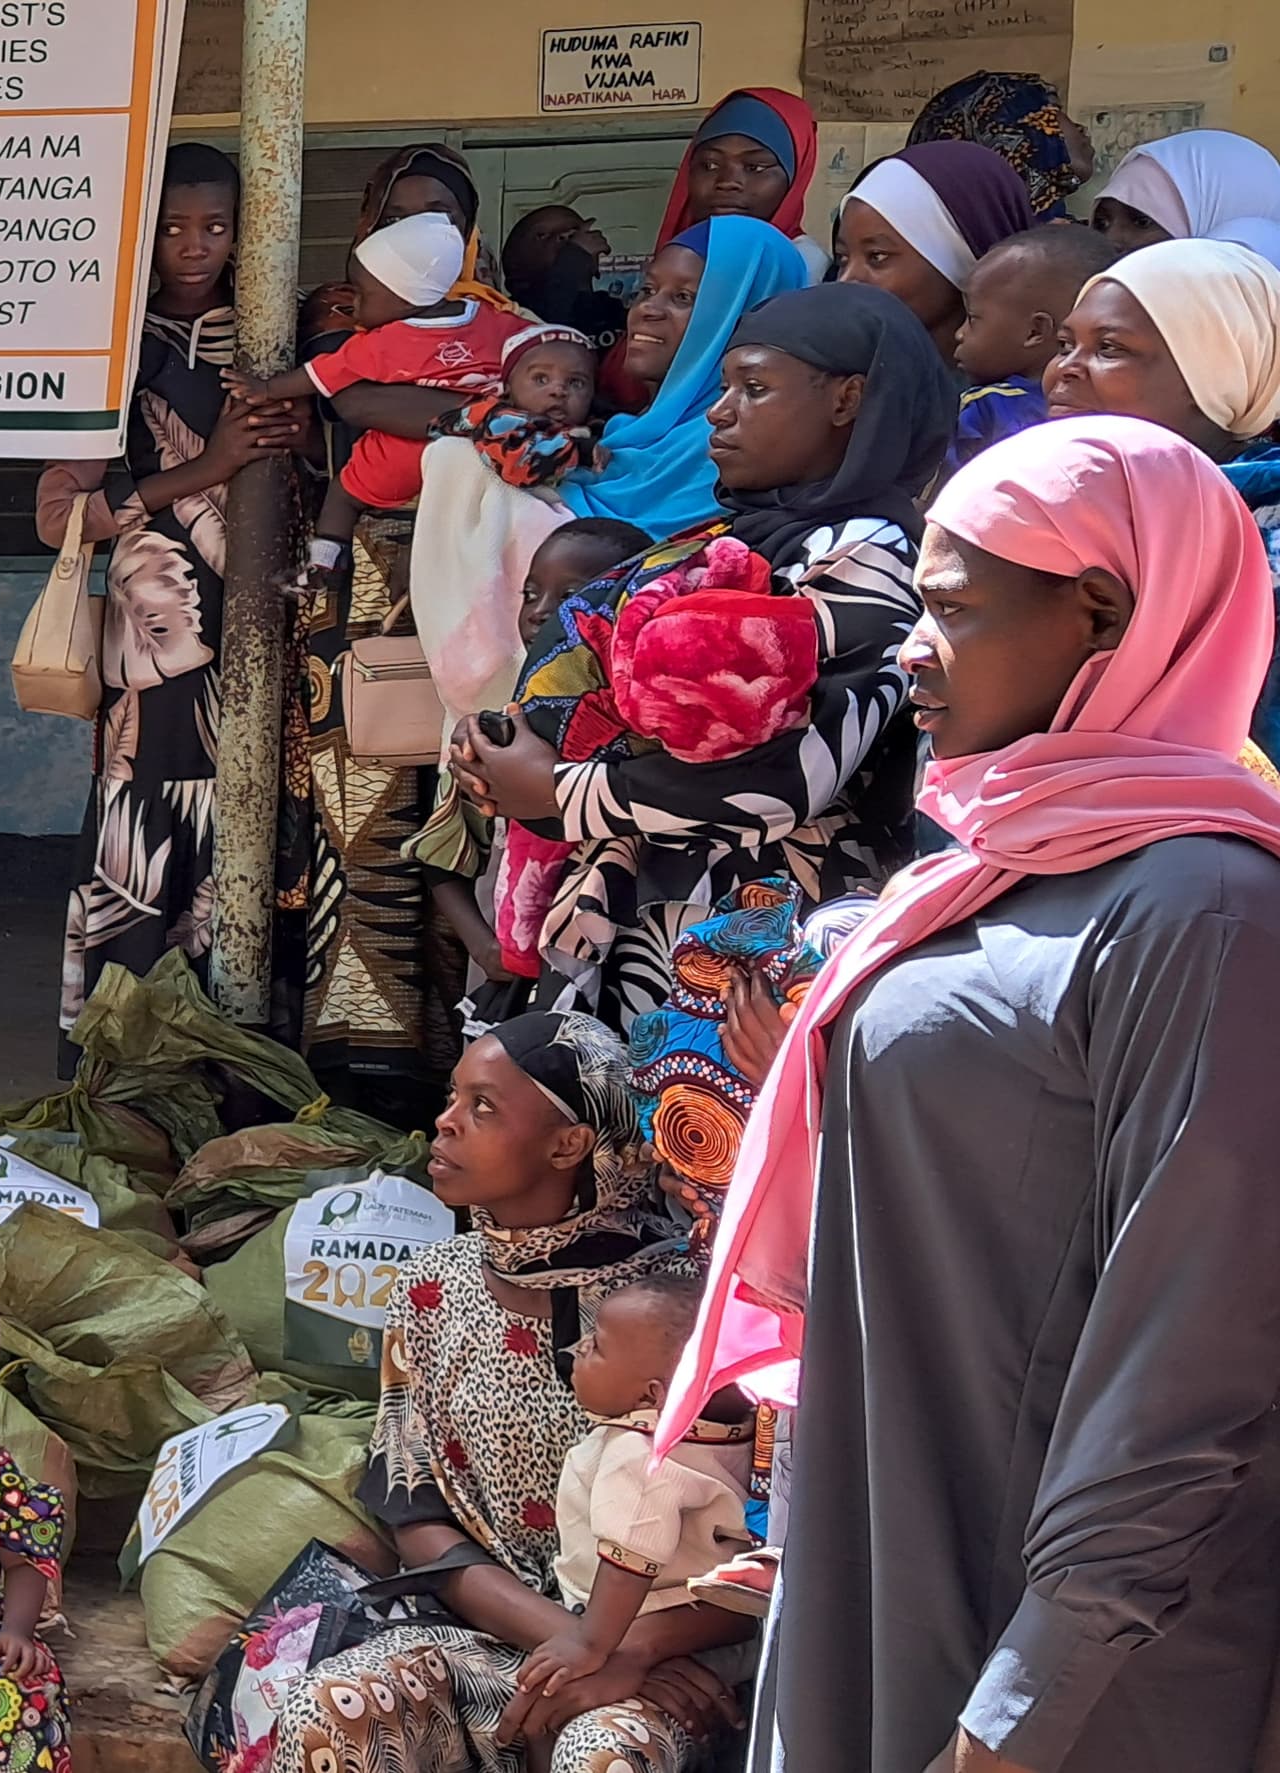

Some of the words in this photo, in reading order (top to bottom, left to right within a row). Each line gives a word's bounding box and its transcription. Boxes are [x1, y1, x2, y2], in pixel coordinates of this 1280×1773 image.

[550, 34, 618, 53] HUDUMA
[629, 30, 690, 49] RAFIKI
[591, 52, 633, 70] KWA
[585, 70, 655, 89] VIJANA
[544, 91, 633, 106] INAPATIKANA
[652, 88, 687, 101] HAPA
[40, 135, 81, 159] NA
[68, 259, 101, 282] YA
[310, 1239, 421, 1263] RAMADA
[302, 1260, 400, 1308] 202
